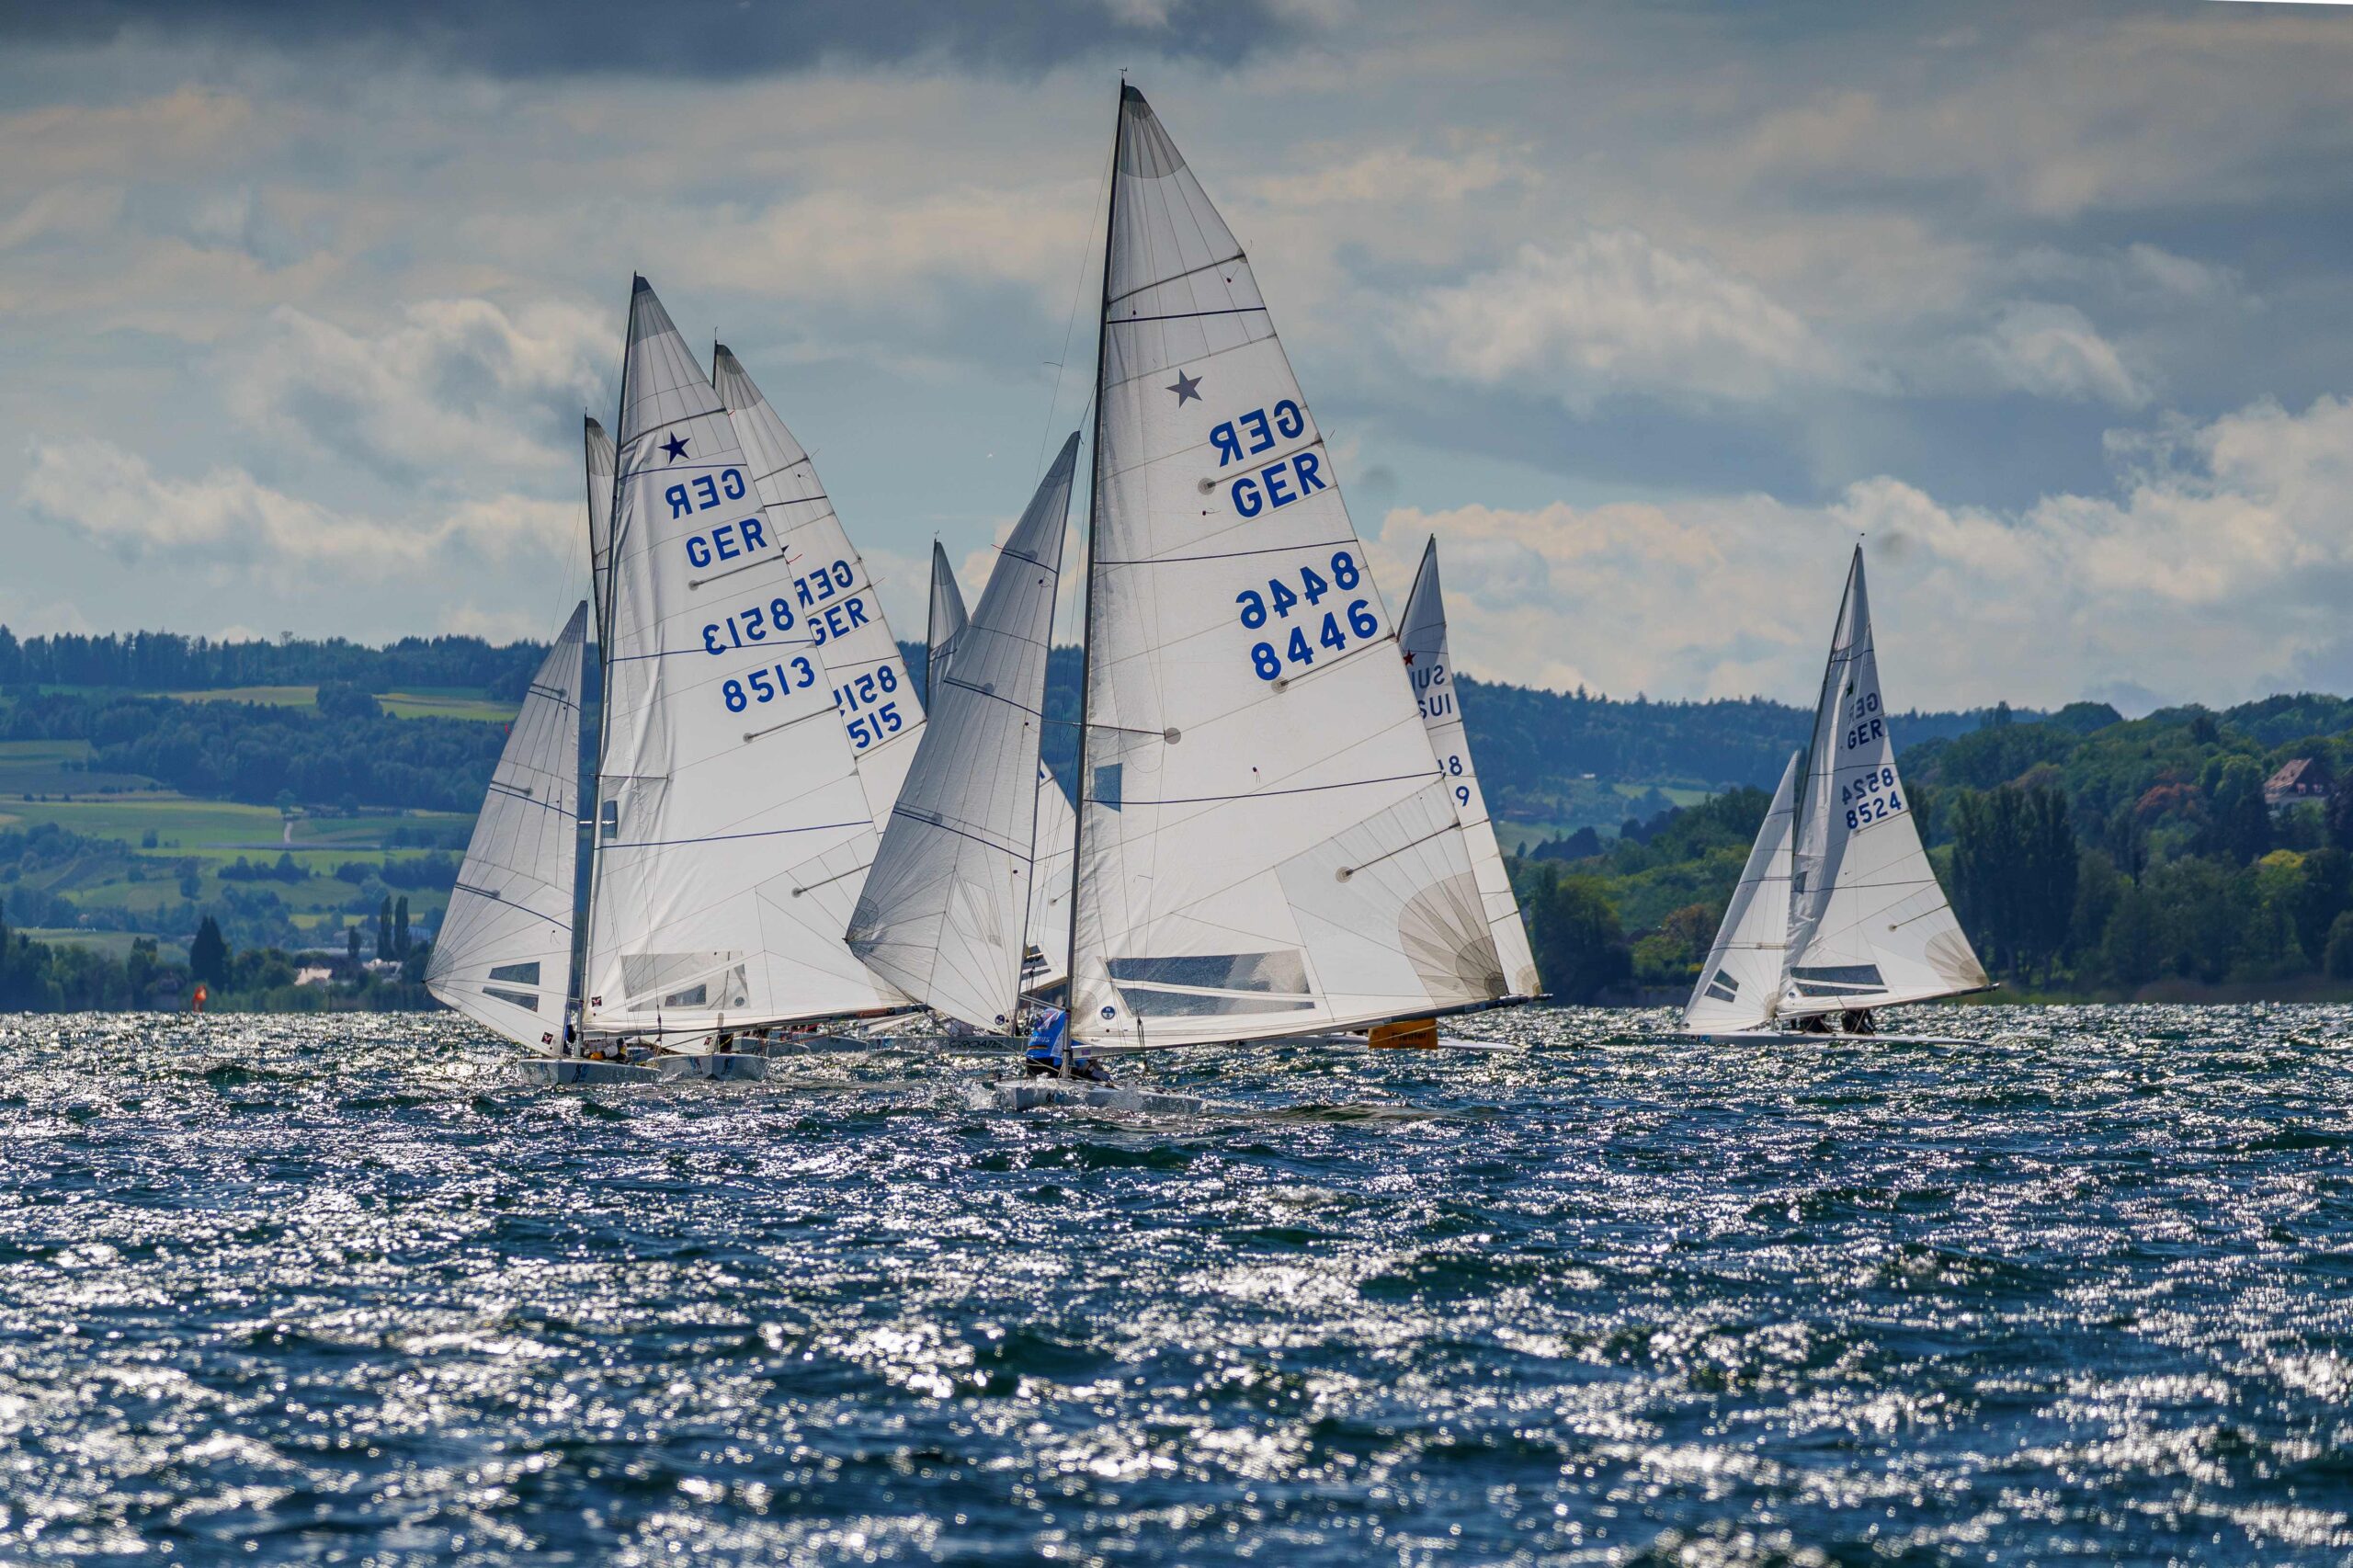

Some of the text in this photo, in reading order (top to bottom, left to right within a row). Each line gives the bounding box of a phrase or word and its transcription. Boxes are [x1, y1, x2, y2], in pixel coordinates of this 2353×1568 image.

[1232, 453, 1325, 517] GER
[687, 517, 767, 568] GER
[808, 597, 869, 646] GER
[1251, 599, 1378, 680] 8446
[722, 656, 815, 712] 8513
[1847, 719, 1882, 749] GER
[1847, 791, 1901, 829] 8524
